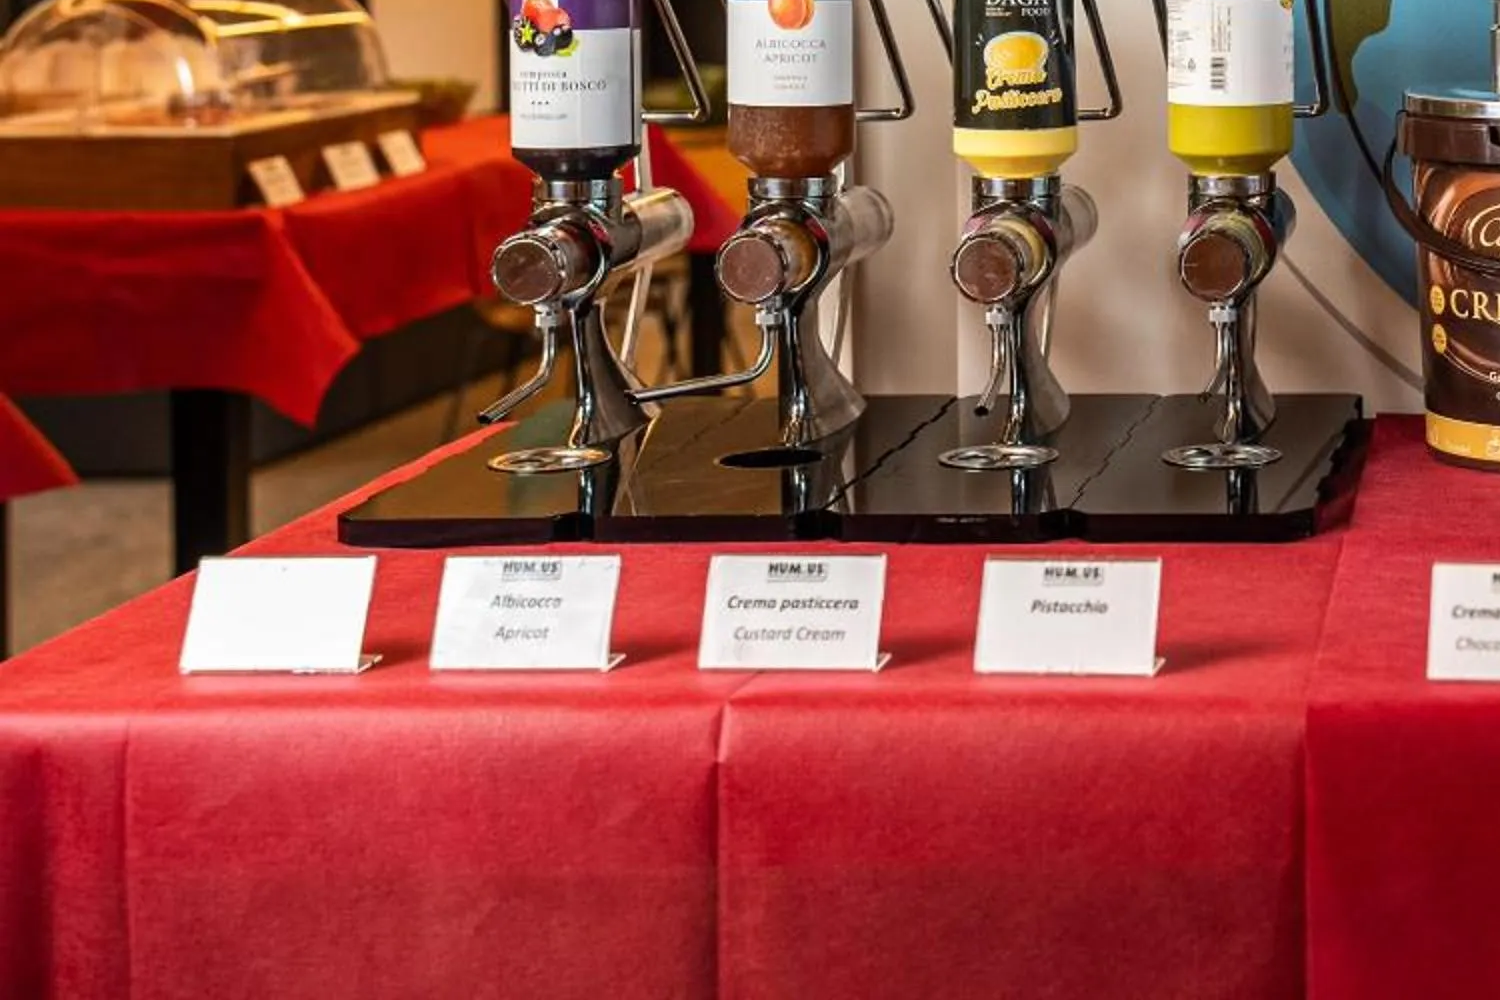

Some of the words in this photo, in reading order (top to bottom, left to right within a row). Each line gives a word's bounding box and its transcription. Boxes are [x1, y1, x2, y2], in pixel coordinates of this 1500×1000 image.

[763, 53, 818, 63] APRICOT
[561, 80, 608, 92] BOSCO
[490, 594, 562, 609] Albicocca
[727, 595, 777, 609] Crema
[779, 596, 860, 612] pasticcera
[1030, 598, 1109, 614] Pistacchio
[494, 626, 549, 642] Apricot
[734, 626, 792, 641] Custard
[796, 626, 846, 641] Cream
